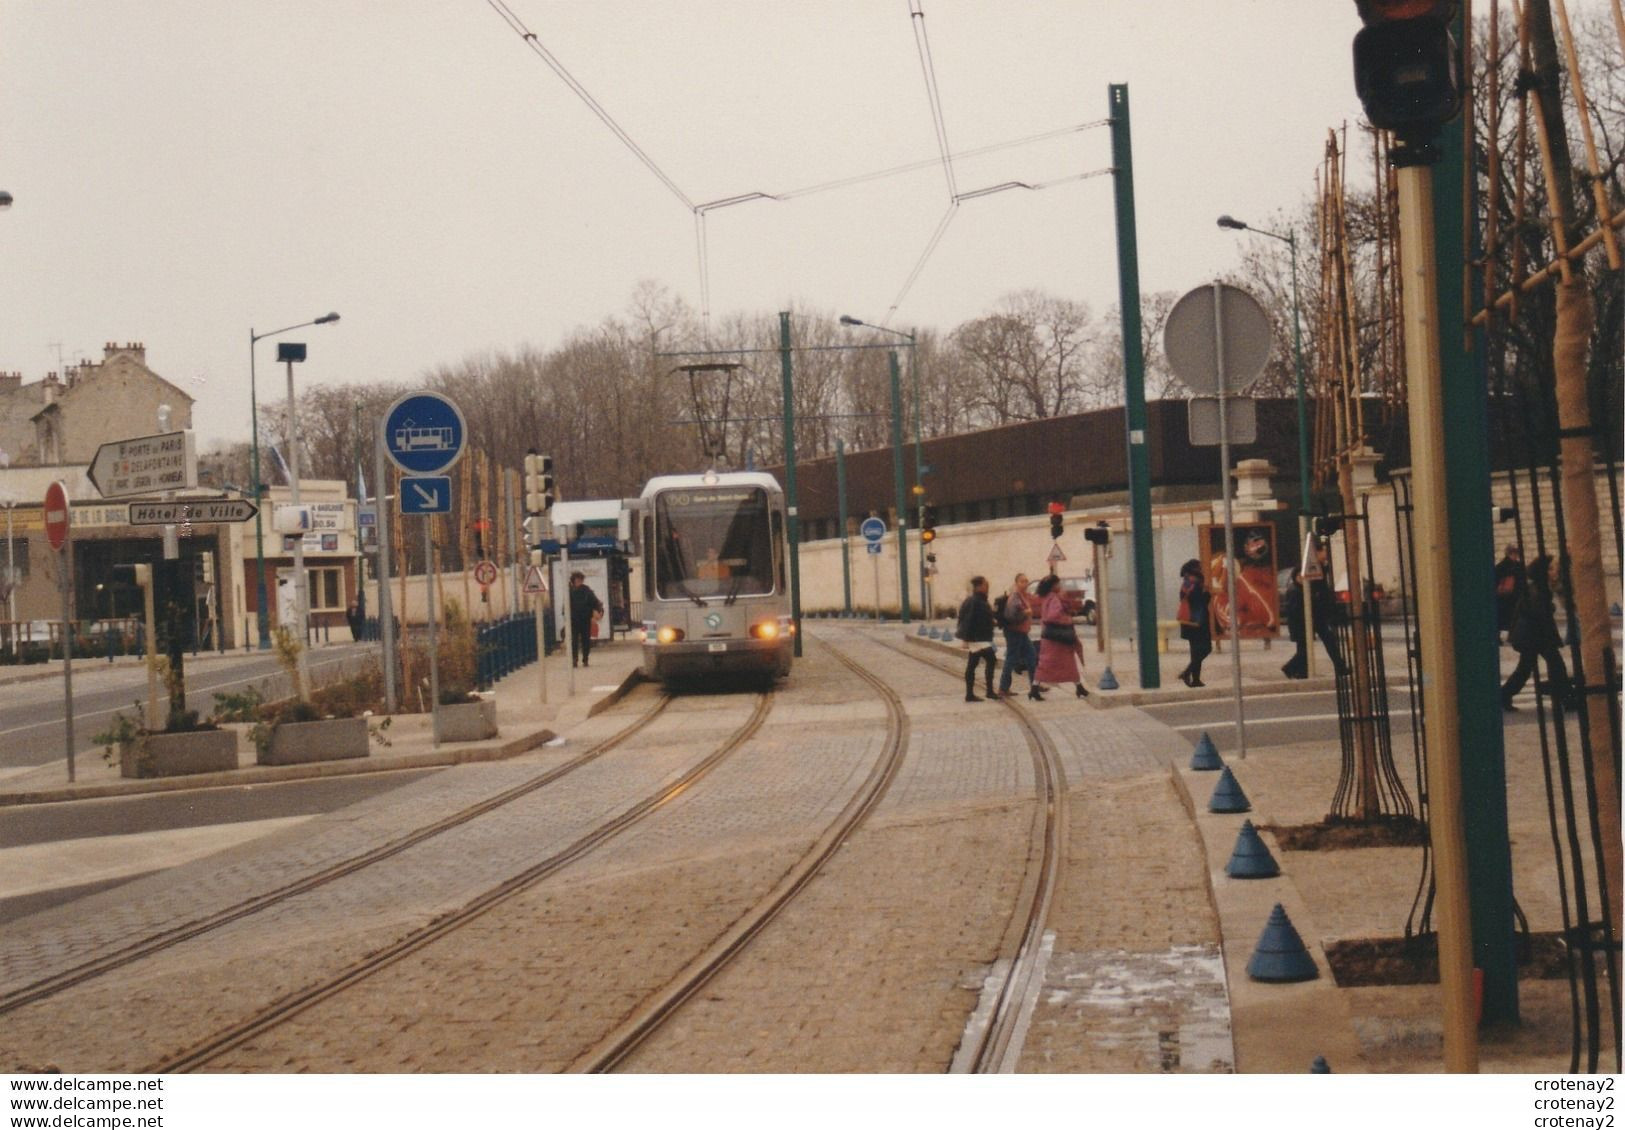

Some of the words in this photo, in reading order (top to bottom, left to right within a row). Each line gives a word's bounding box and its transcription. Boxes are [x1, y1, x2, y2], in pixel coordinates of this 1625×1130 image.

[128, 444, 151, 457] PORTE
[160, 439, 183, 452] PARIS
[130, 454, 183, 473] DELAFONTAINE
[138, 506, 177, 520] Hôtel
[186, 506, 202, 519] de
[209, 505, 244, 518] Ville
